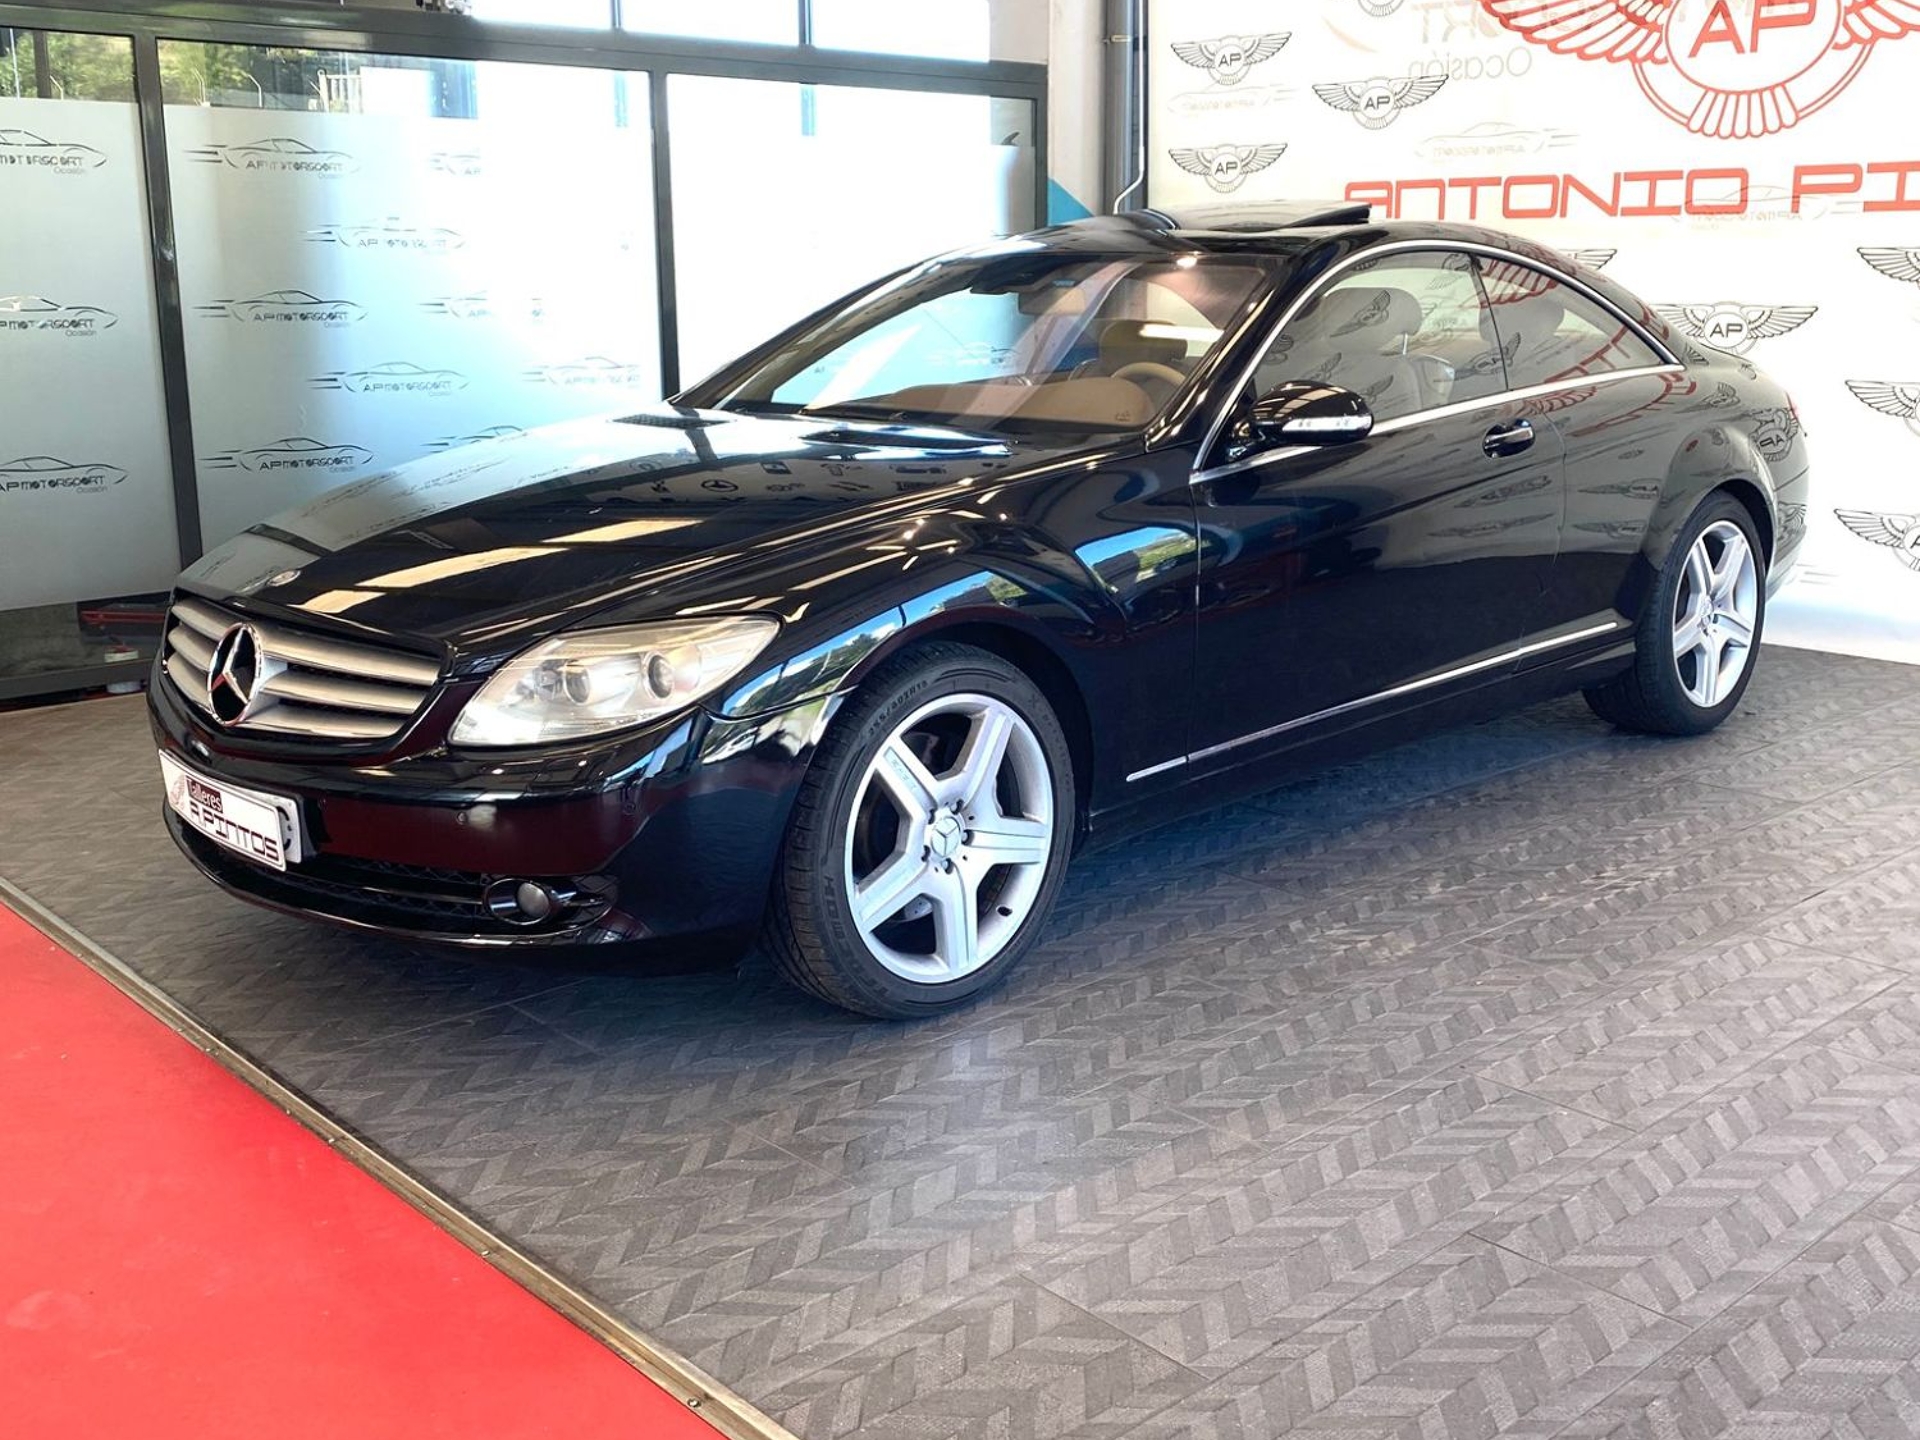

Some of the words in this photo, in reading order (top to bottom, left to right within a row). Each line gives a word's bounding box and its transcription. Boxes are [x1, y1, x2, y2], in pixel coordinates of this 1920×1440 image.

[1688, 0, 1817, 58] AP
[1218, 52, 1242, 67] AP
[1363, 95, 1391, 110] AP
[1214, 161, 1238, 175] AP
[1344, 168, 1749, 220] ANTONIO
[1709, 322, 1743, 338] AP
[186, 778, 223, 813] Talleres
